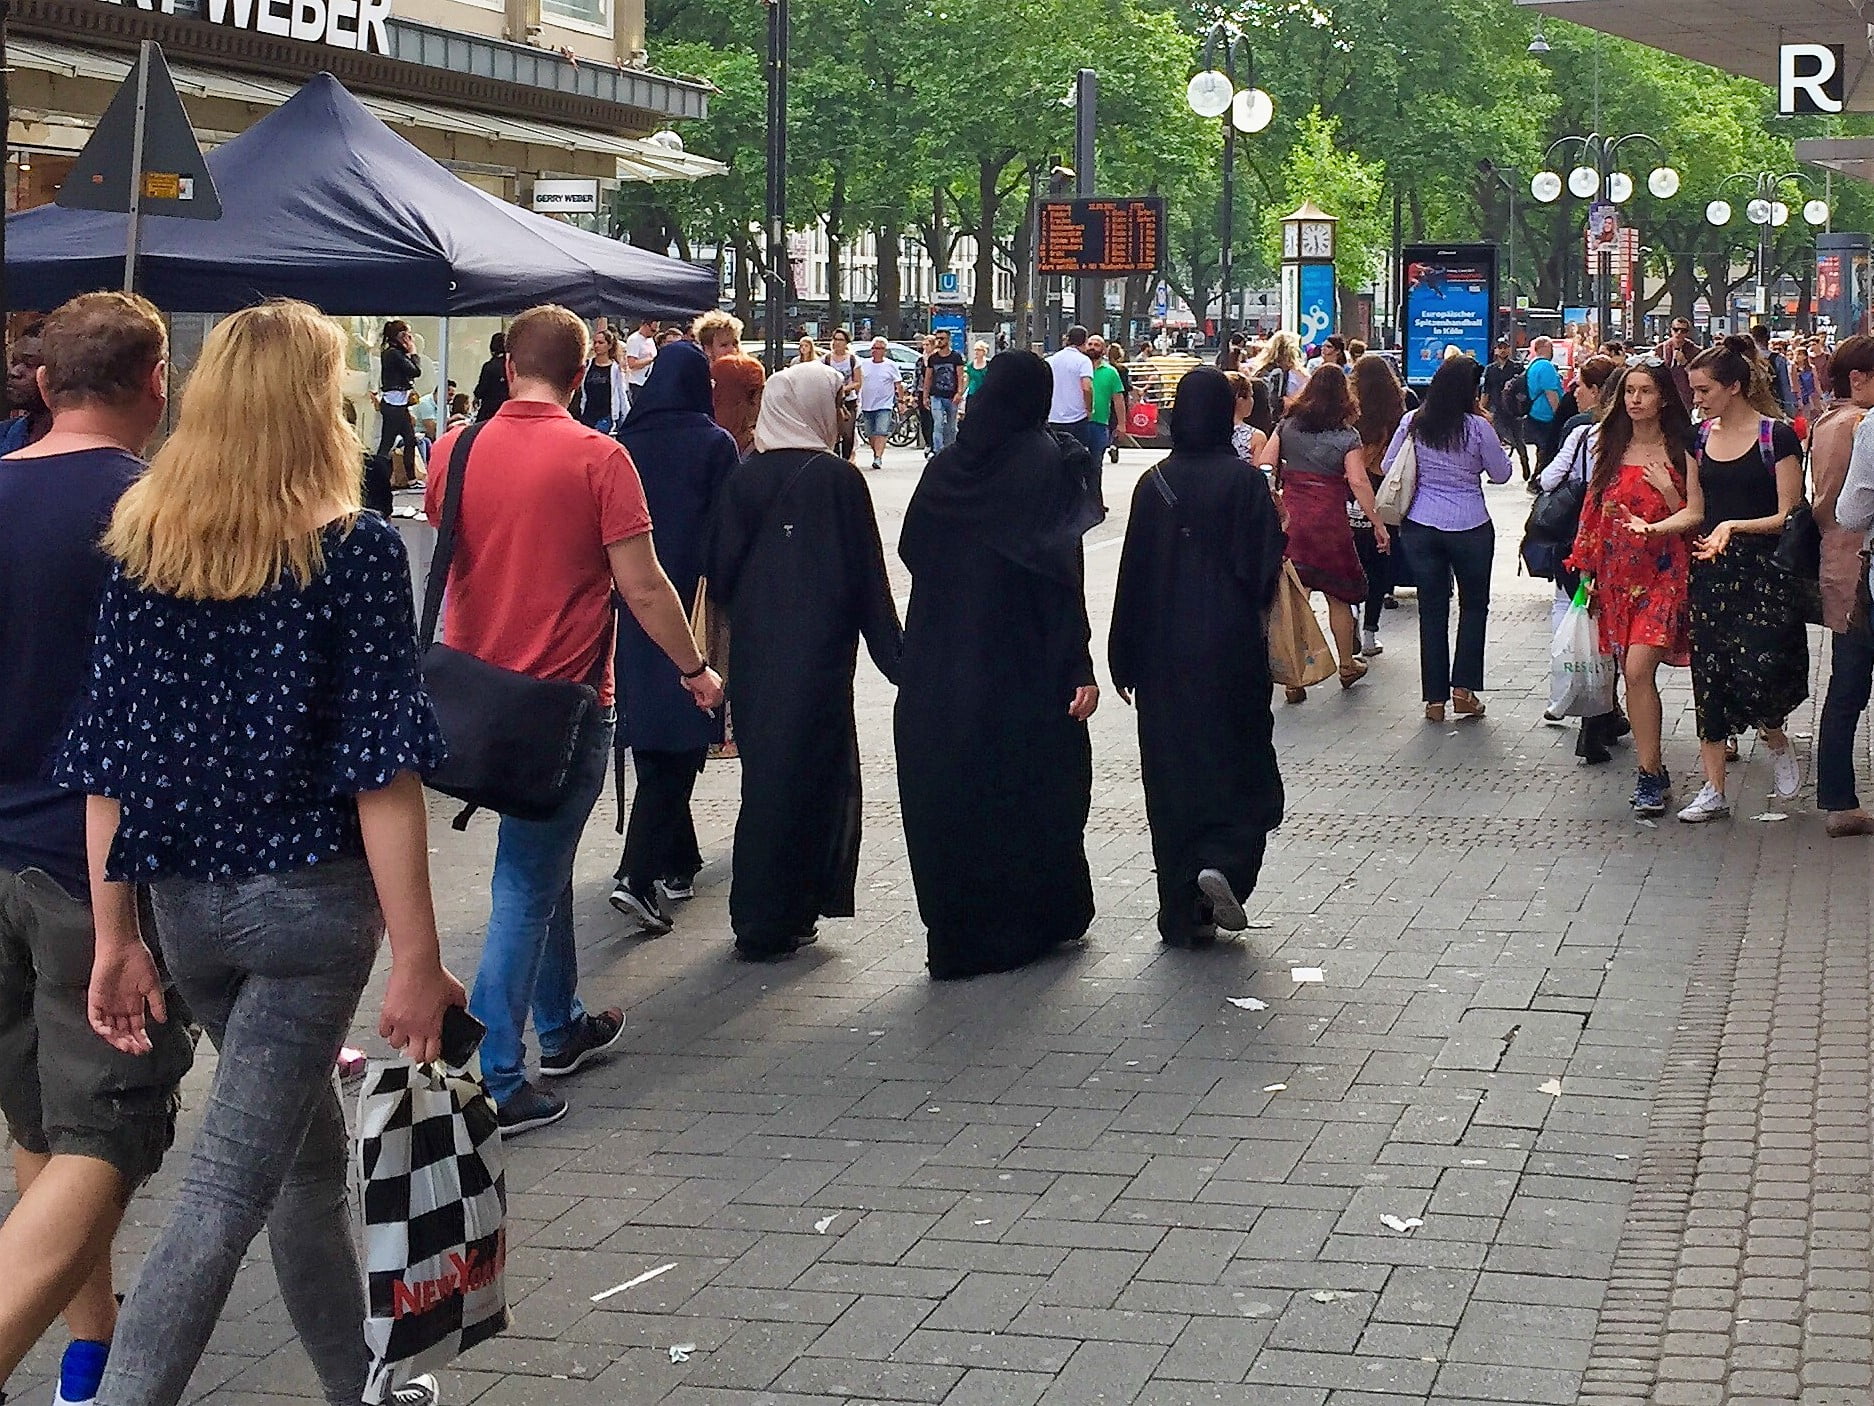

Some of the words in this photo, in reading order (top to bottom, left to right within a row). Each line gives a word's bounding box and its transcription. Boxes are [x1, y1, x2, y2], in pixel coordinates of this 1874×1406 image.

[1780, 44, 1842, 112] R
[536, 194, 563, 203] GERRY
[564, 194, 594, 203] WEBER
[943, 275, 954, 289] U
[1443, 326, 1464, 335] Köln
